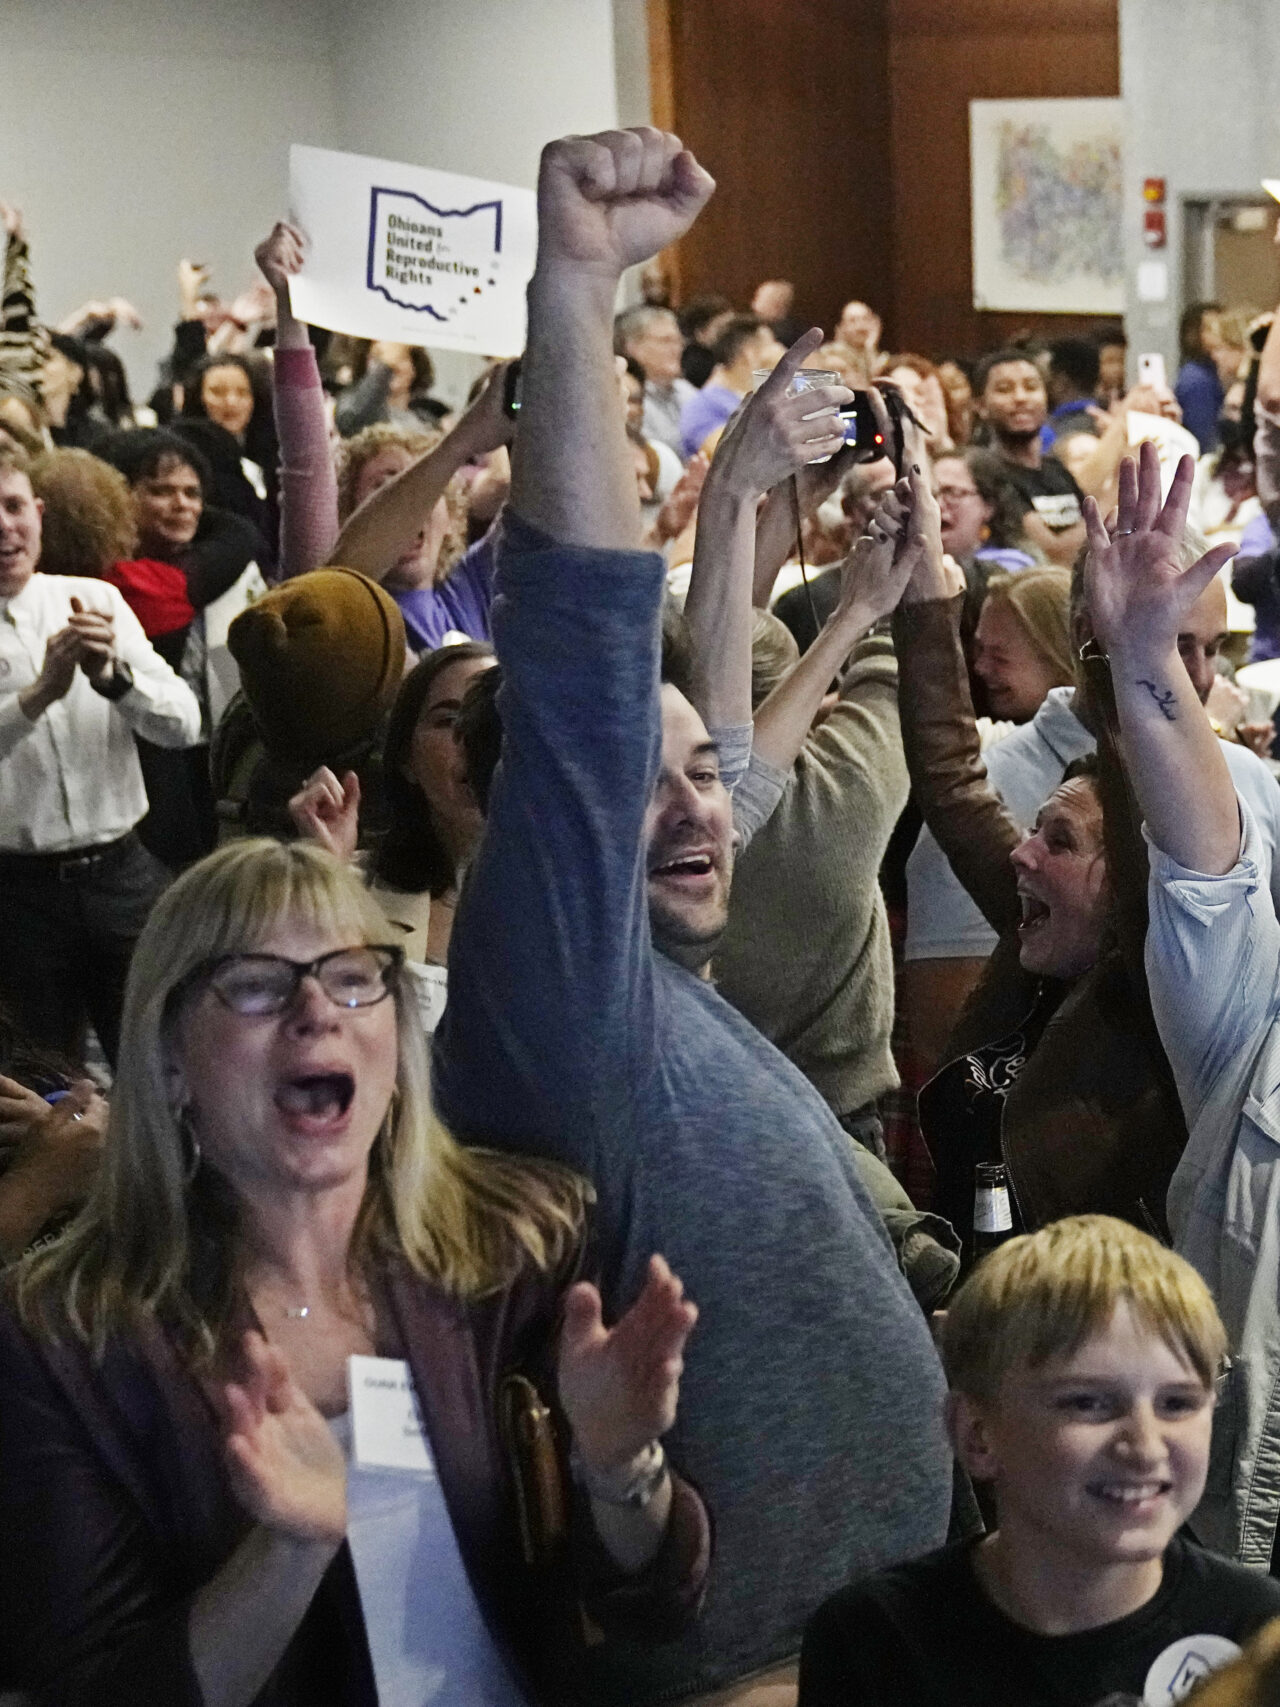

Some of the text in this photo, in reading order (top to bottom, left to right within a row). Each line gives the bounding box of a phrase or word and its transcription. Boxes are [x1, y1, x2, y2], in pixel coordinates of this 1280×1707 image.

[388, 214, 443, 238] Ohioans
[387, 231, 433, 252] United
[386, 248, 479, 277] Reproductive
[386, 265, 432, 285] Rights
